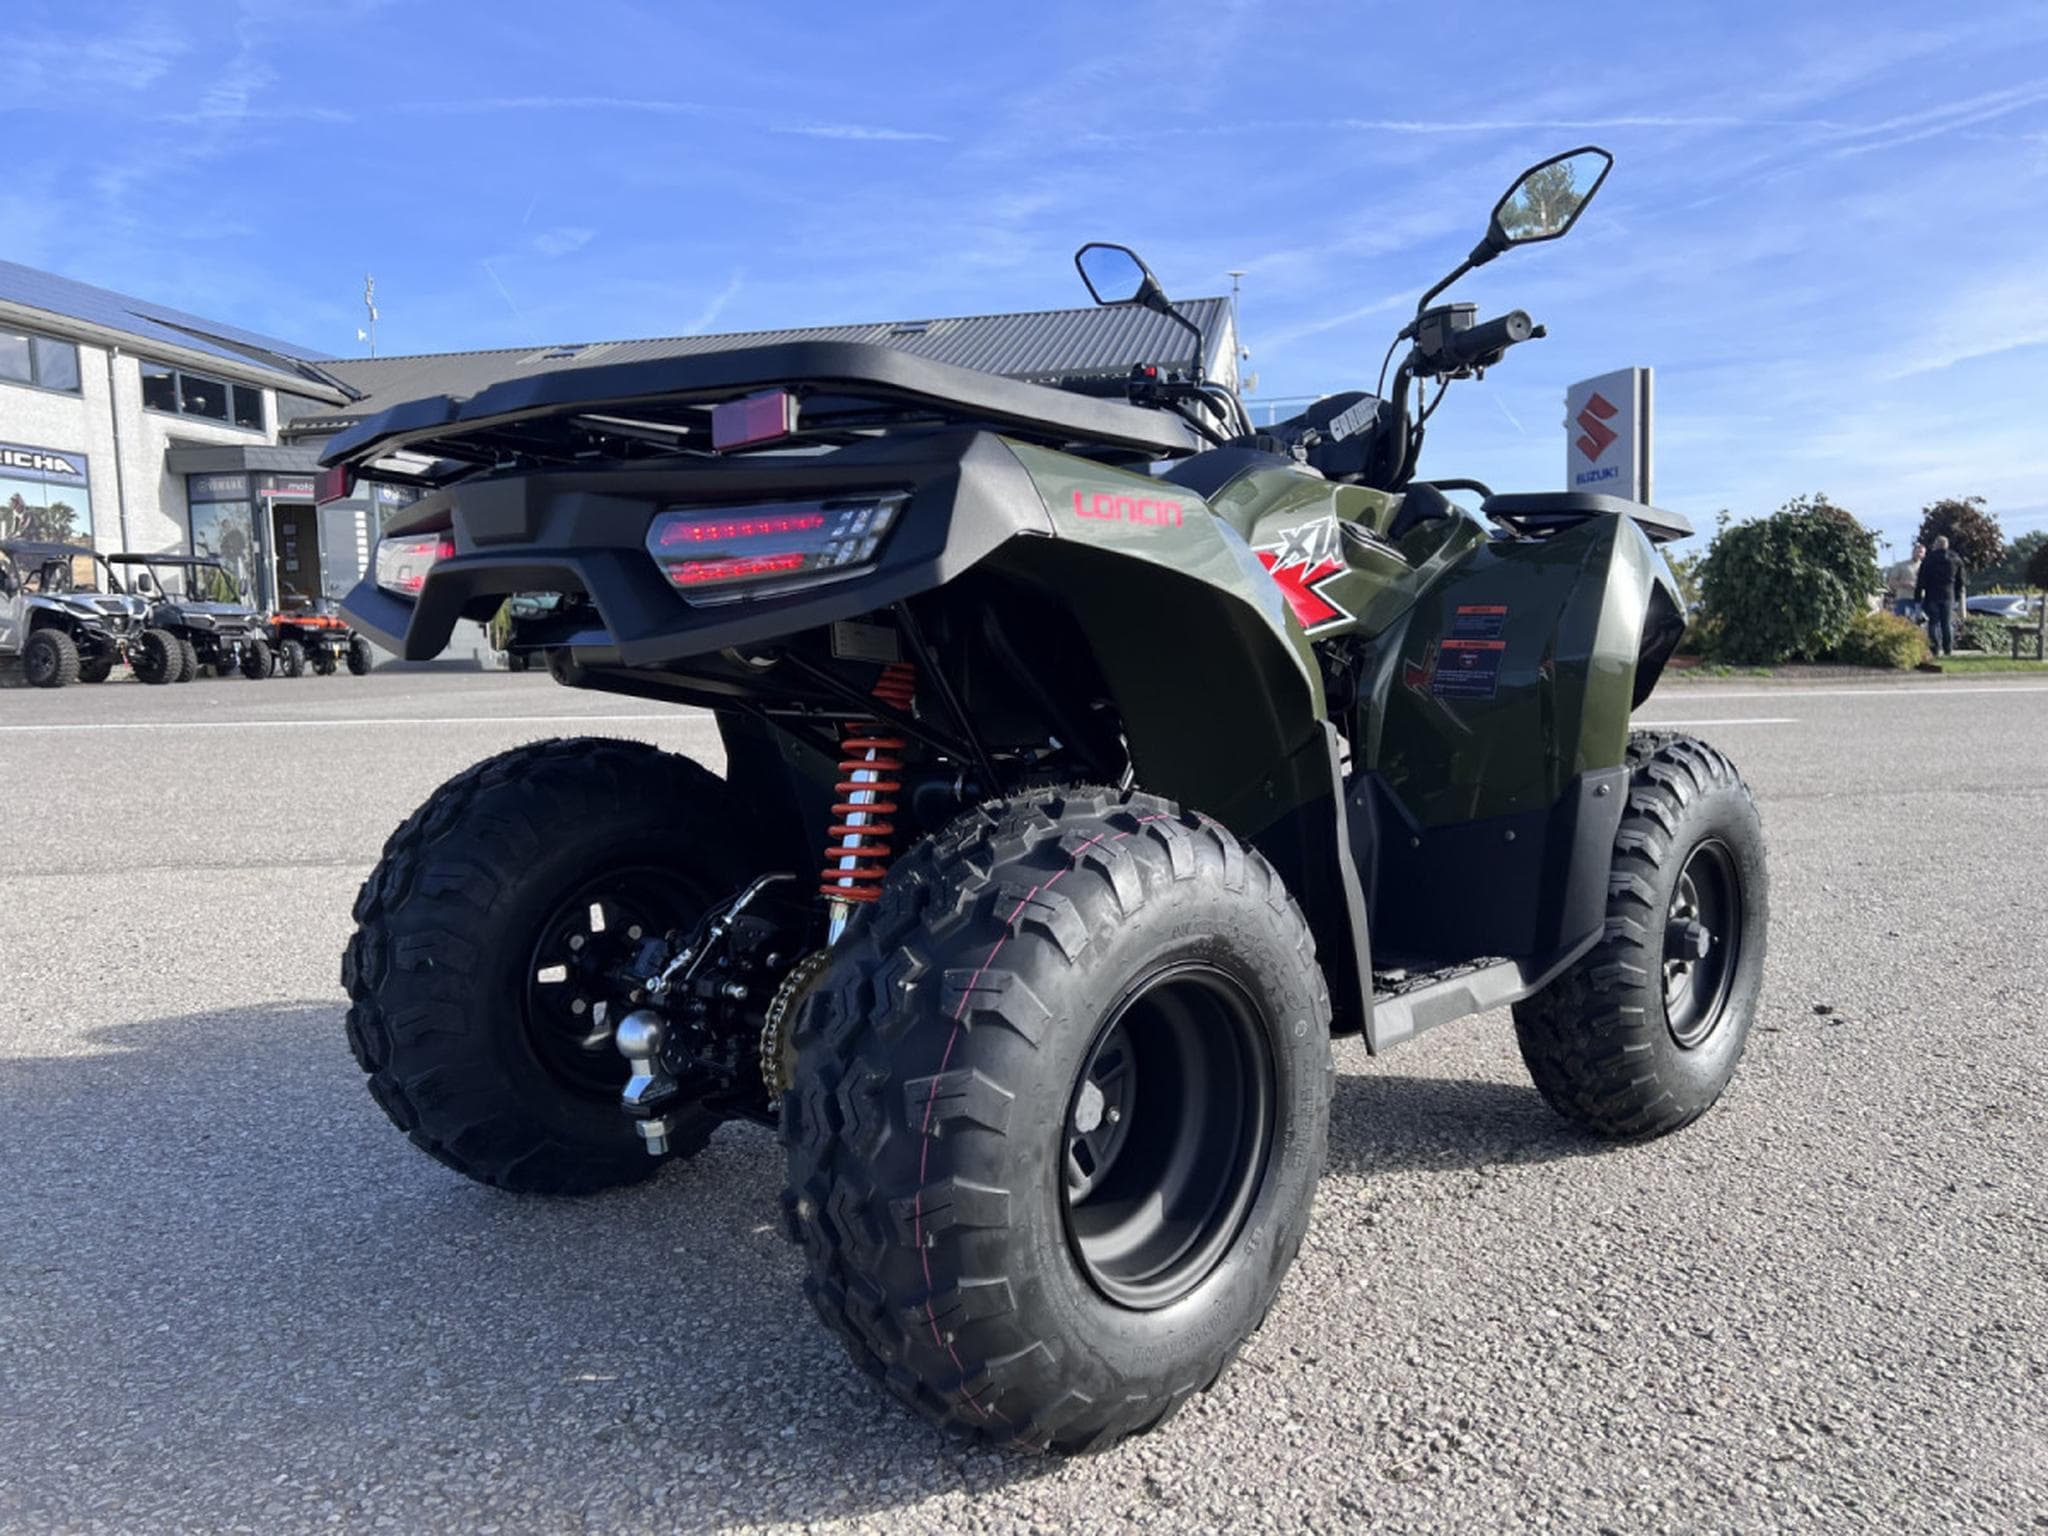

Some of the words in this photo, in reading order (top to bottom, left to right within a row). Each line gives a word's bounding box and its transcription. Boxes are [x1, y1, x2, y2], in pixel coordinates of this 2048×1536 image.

[0, 449, 82, 476] ICHA
[1576, 466, 1619, 485] SUZUKI
[1072, 489, 1183, 529] LONCIN
